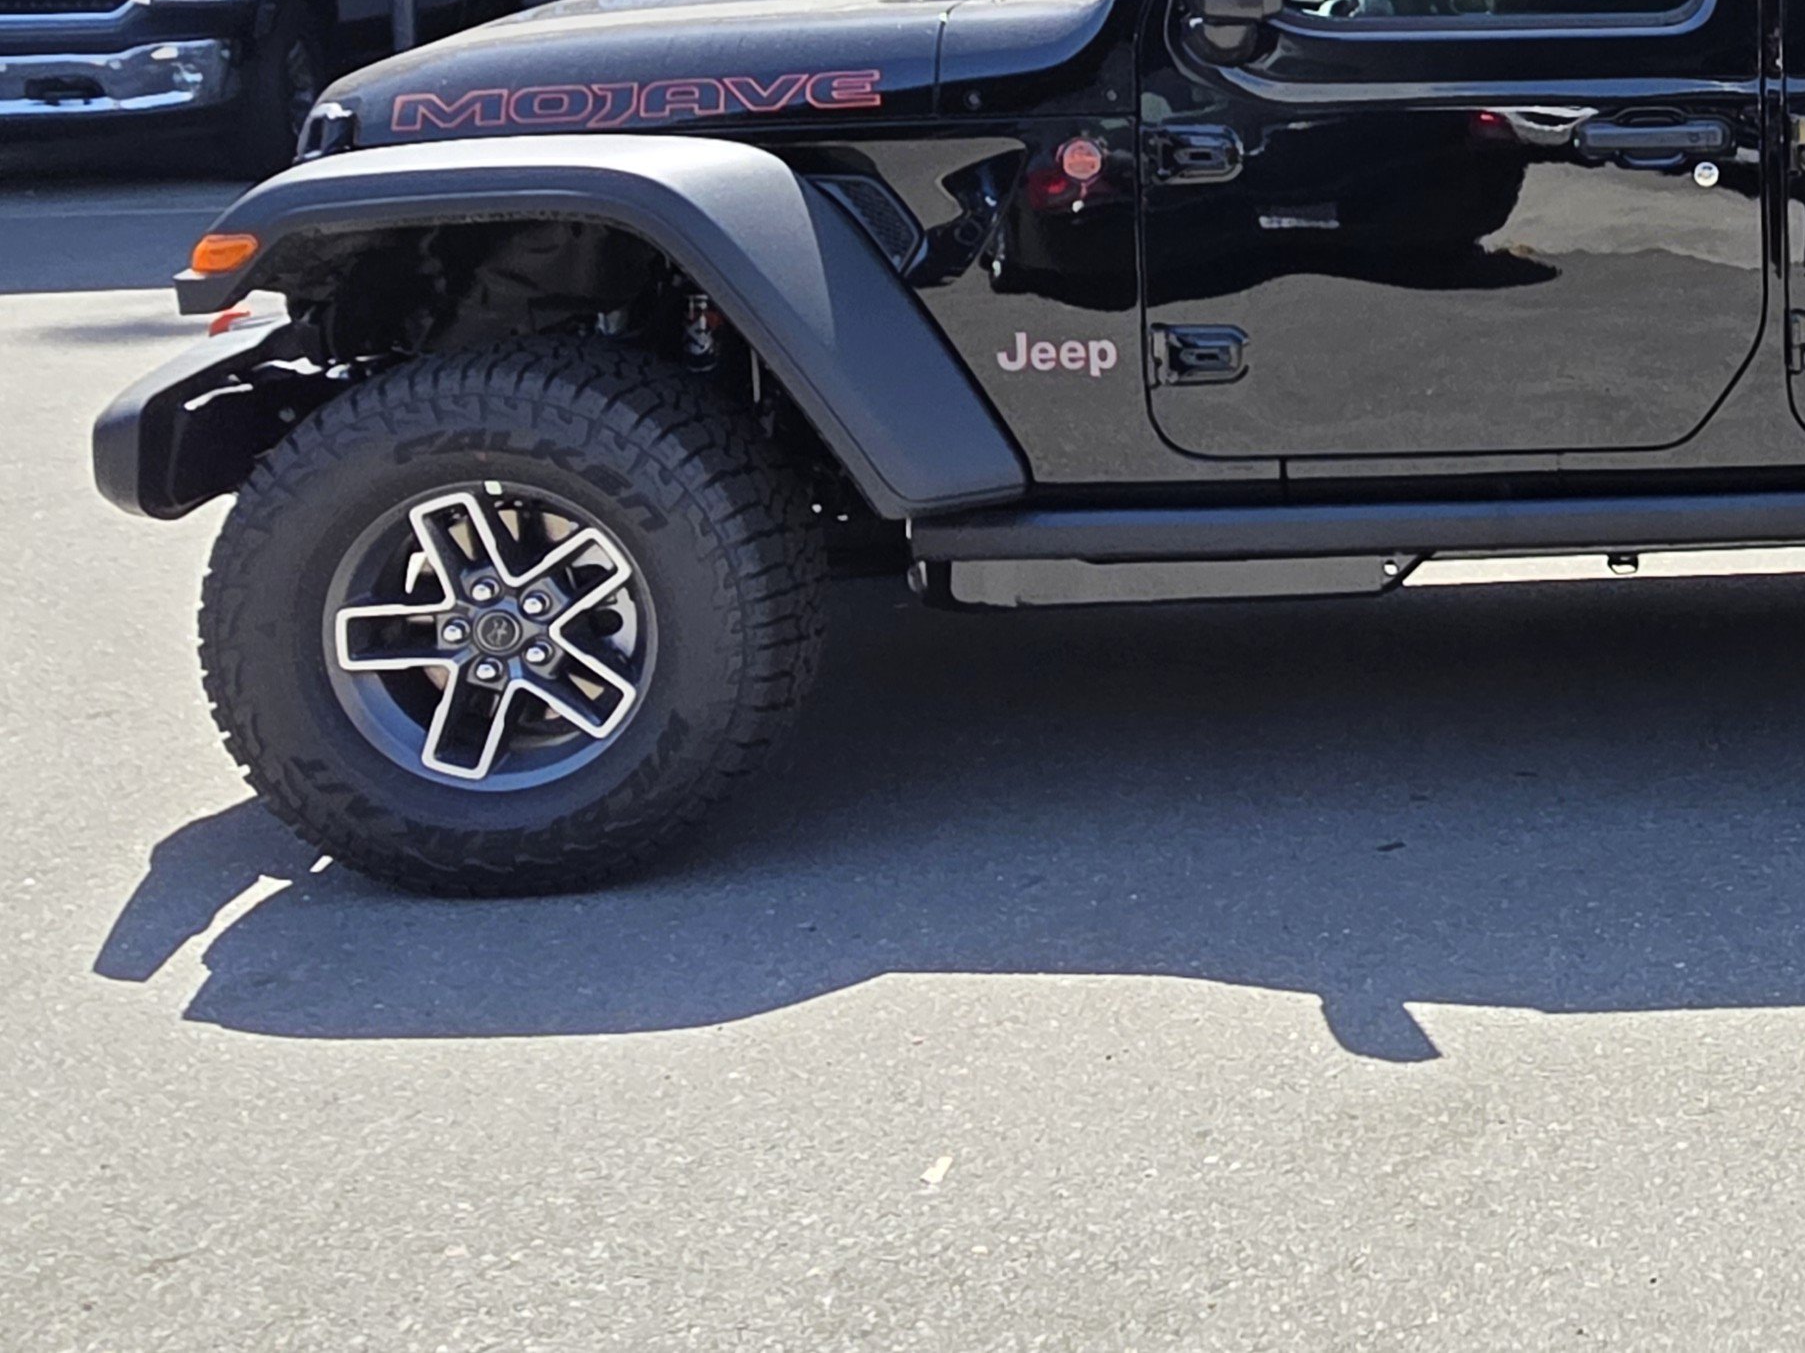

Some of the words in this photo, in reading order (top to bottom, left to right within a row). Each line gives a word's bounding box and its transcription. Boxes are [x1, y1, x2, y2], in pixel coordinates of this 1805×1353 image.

[391, 70, 880, 131] MOJAVE
[997, 332, 1118, 377] Jeep
[394, 427, 669, 532] FALKEN
